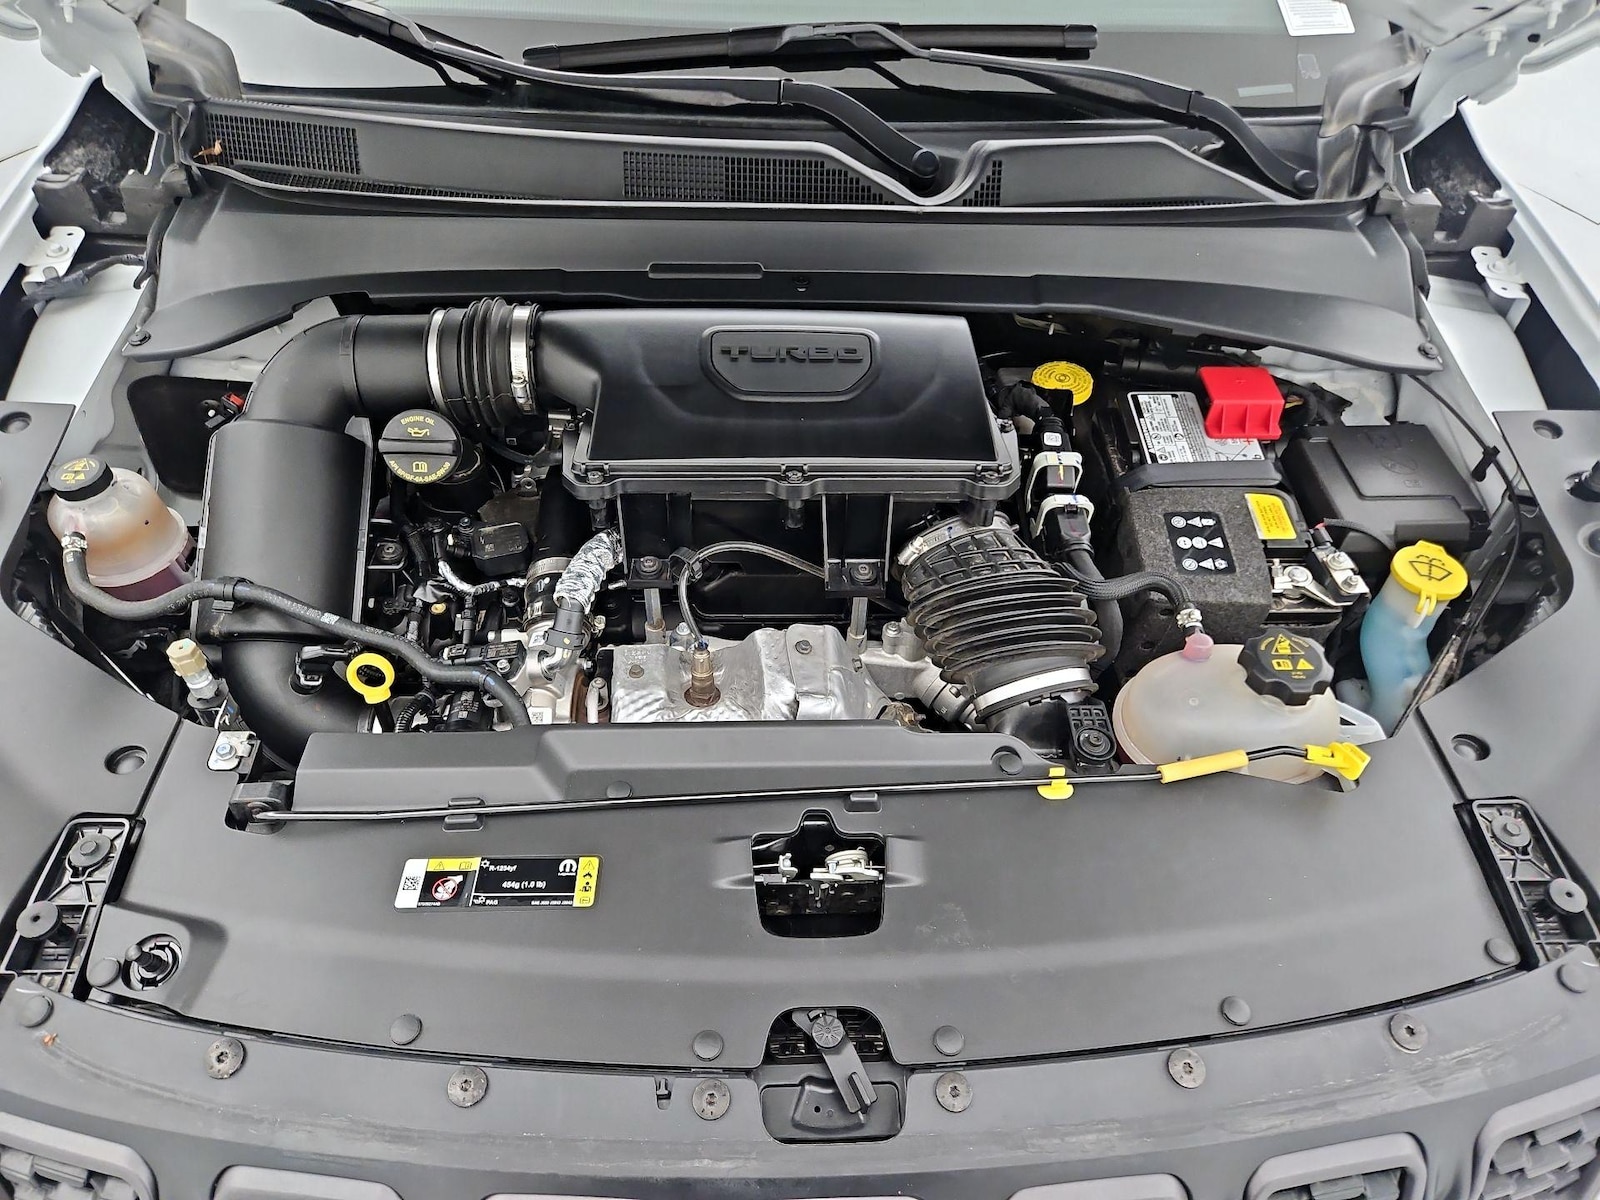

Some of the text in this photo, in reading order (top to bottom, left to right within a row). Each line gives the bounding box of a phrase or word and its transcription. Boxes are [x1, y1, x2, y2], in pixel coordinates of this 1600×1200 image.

[720, 346, 864, 363] TURBO
[400, 415, 435, 425] ENGINE OIL
[502, 881, 520, 890] 454g
[521, 881, 535, 890] (1.0
